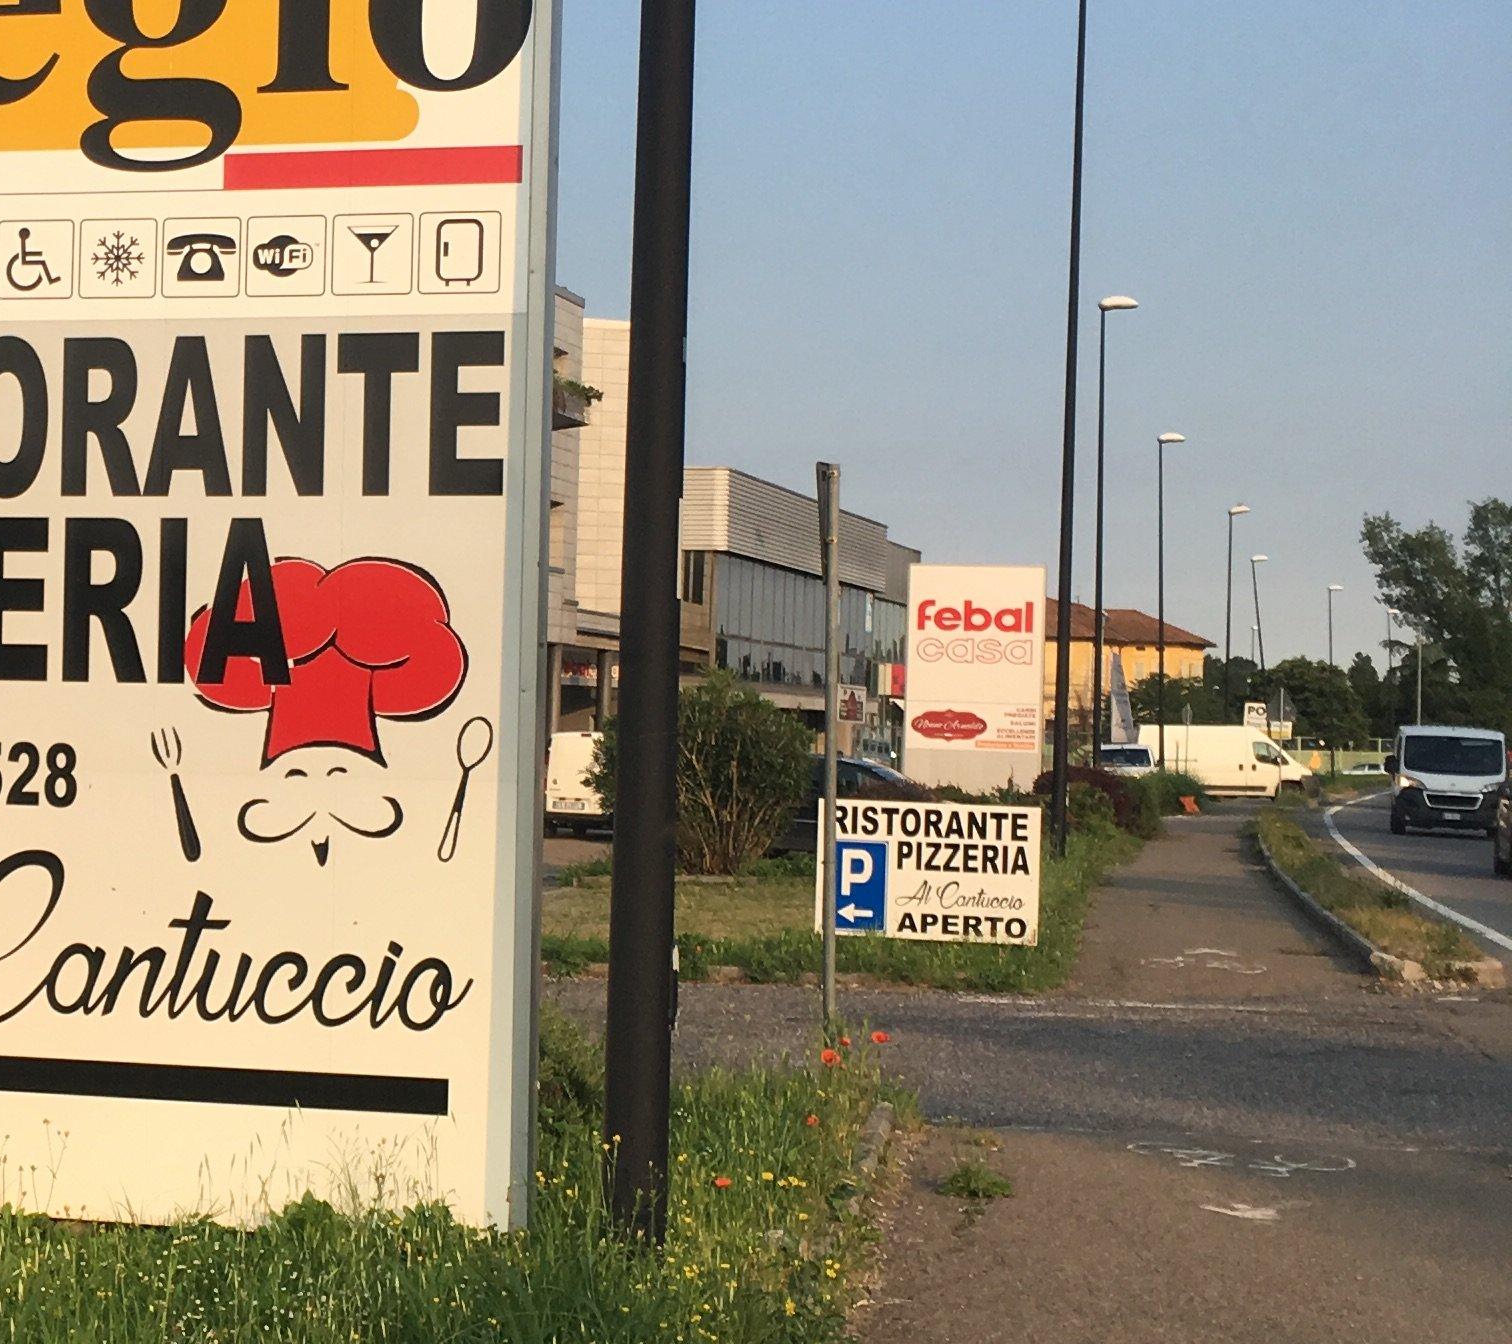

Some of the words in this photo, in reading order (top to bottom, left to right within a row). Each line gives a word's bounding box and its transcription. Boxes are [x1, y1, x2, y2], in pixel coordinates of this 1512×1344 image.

[917, 599, 1034, 633] febal
[916, 637, 1033, 665] casa
[836, 806, 1029, 841] RISTORANTE
[841, 848, 873, 896] P
[897, 841, 1030, 876] PIZZERIA
[895, 880, 932, 906] Al
[936, 881, 1025, 911] Cantuccio
[897, 912, 1027, 939] APERTO
